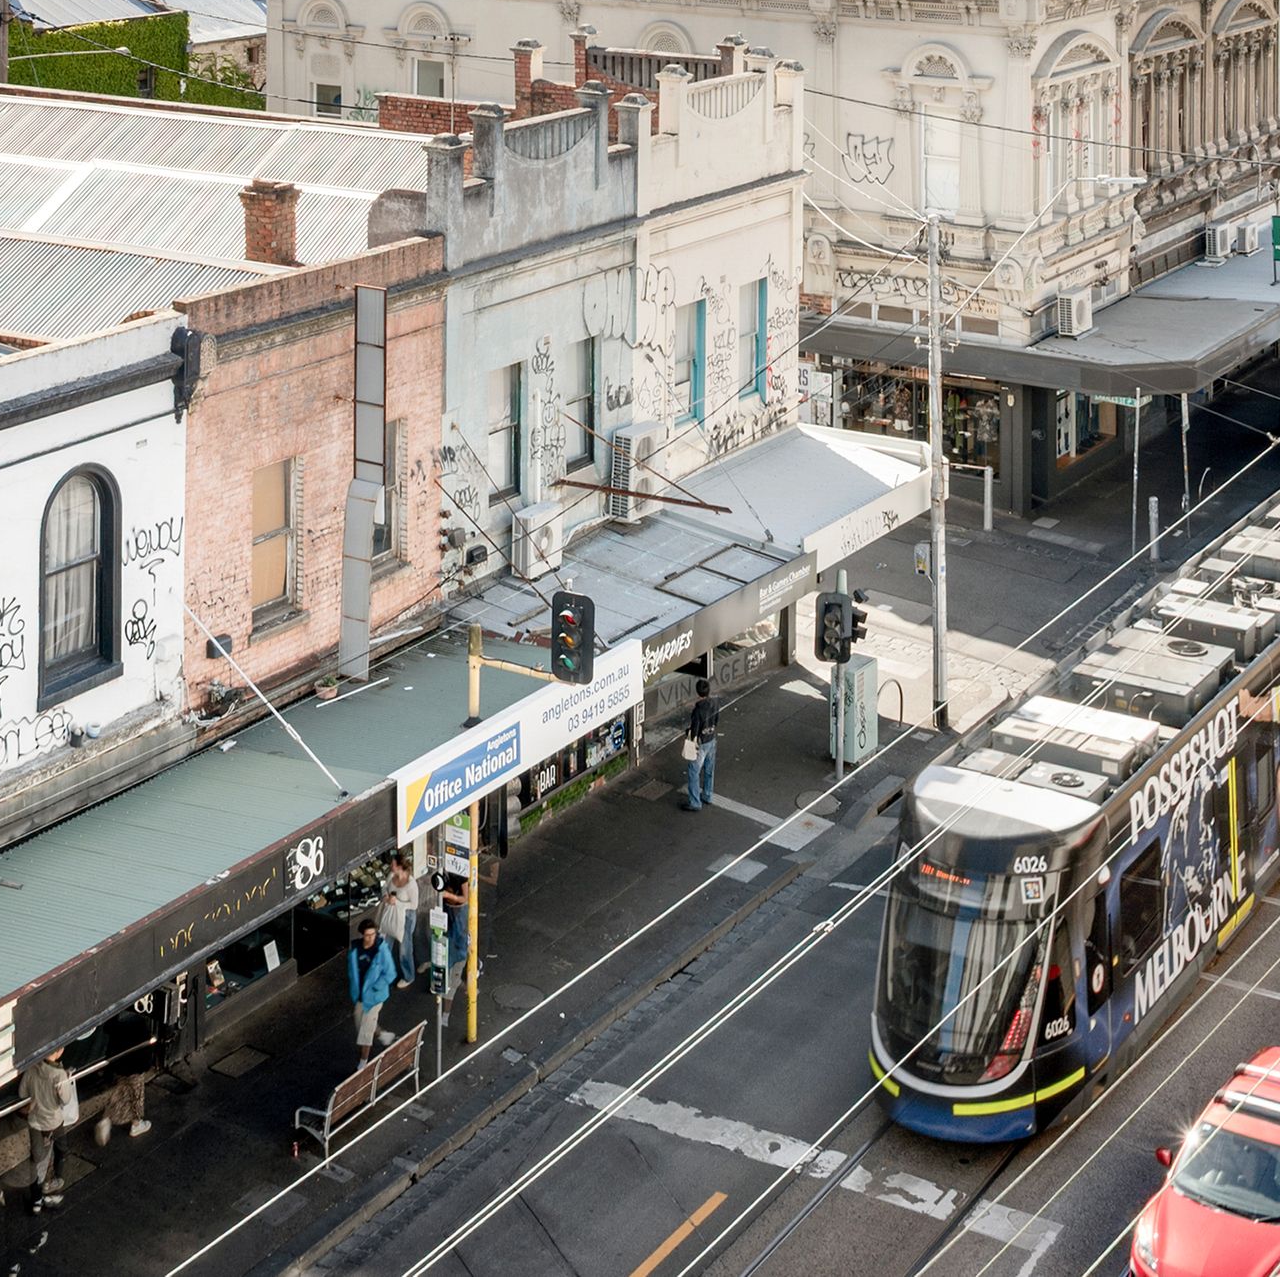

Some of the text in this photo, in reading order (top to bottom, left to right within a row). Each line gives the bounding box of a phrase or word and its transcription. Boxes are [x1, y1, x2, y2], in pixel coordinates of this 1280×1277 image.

[542, 663, 630, 724] angletons.com.au
[660, 659, 740, 706] VINAGE
[567, 685, 630, 732] 03 9419 5855
[486, 728, 517, 752] Angletons
[424, 738, 517, 813] Office National
[539, 764, 557, 793] BAR
[1128, 698, 1240, 846] POSSESHOT
[296, 836, 325, 890] 86
[1013, 855, 1048, 874] 6026
[1134, 852, 1246, 1023] MELBOURNE
[1045, 1015, 1070, 1040] 6026
